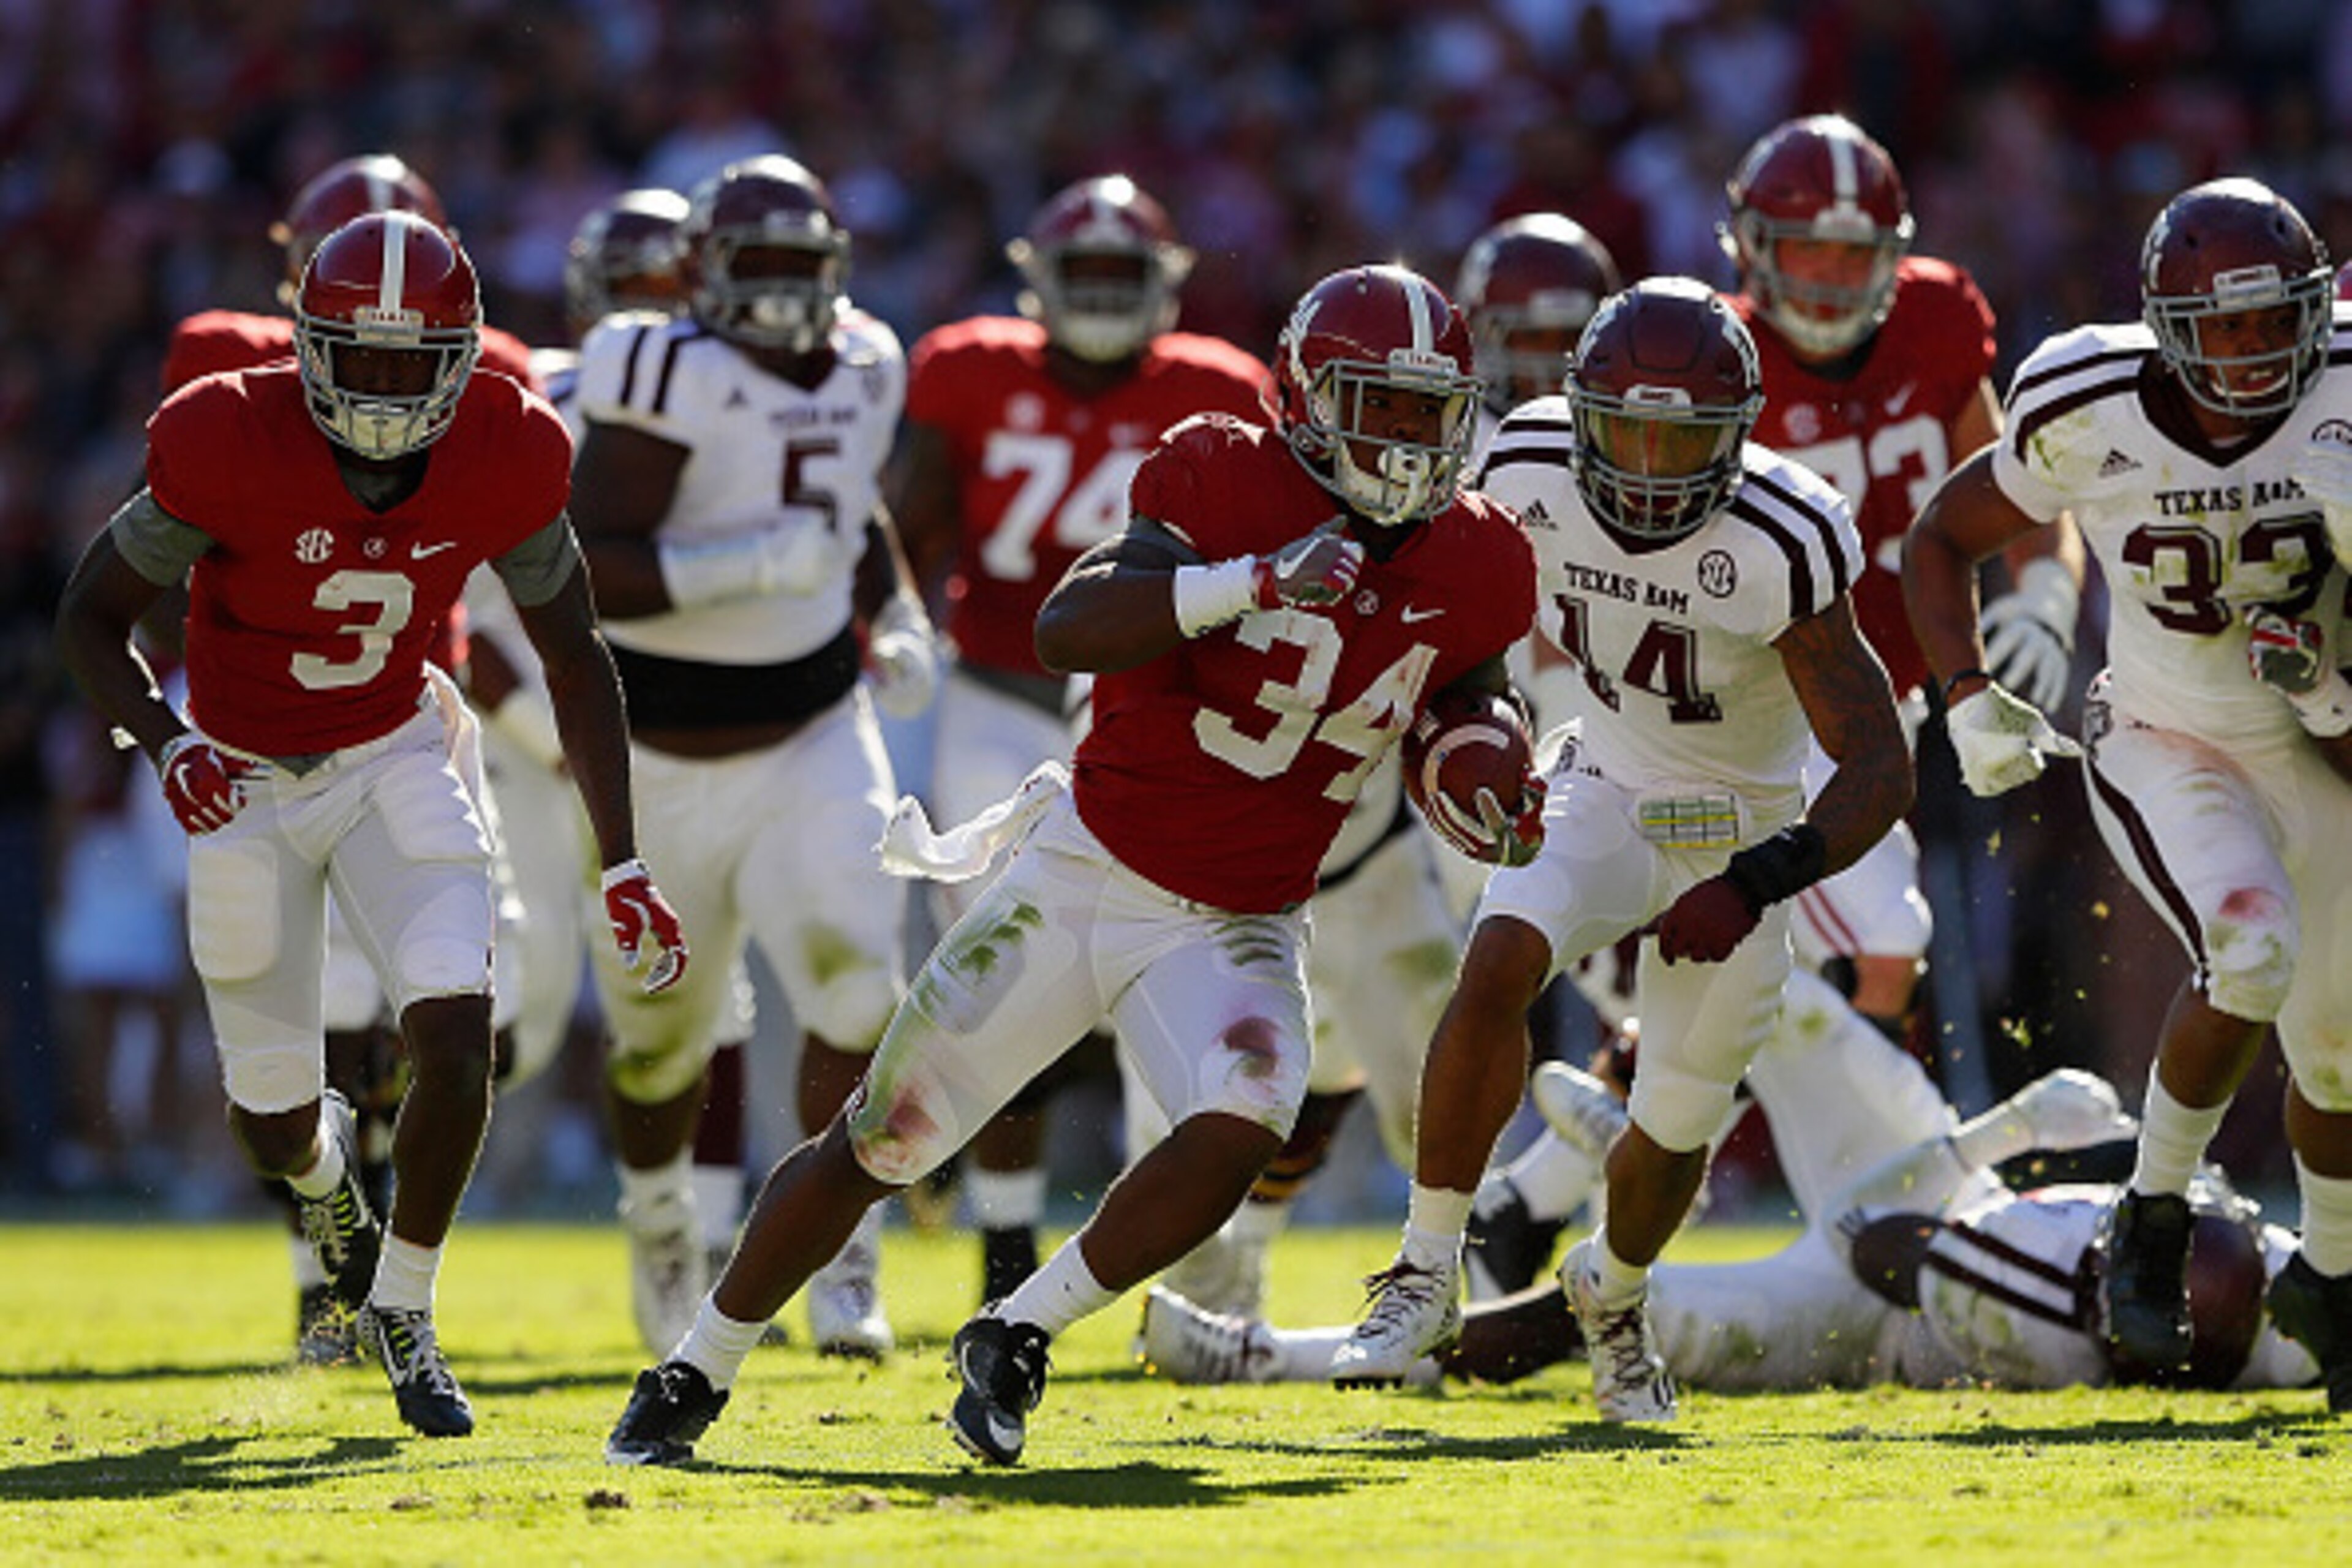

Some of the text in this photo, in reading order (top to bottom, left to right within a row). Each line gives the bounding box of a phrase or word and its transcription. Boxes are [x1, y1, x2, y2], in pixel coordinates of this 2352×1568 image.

[782, 439, 840, 532] 5
[2154, 486, 2243, 517] TEXAS
[289, 570, 415, 690] 3
[1563, 561, 1640, 603] TEXAS
[1191, 609, 1441, 804] 34
[1553, 592, 1723, 724] 14
